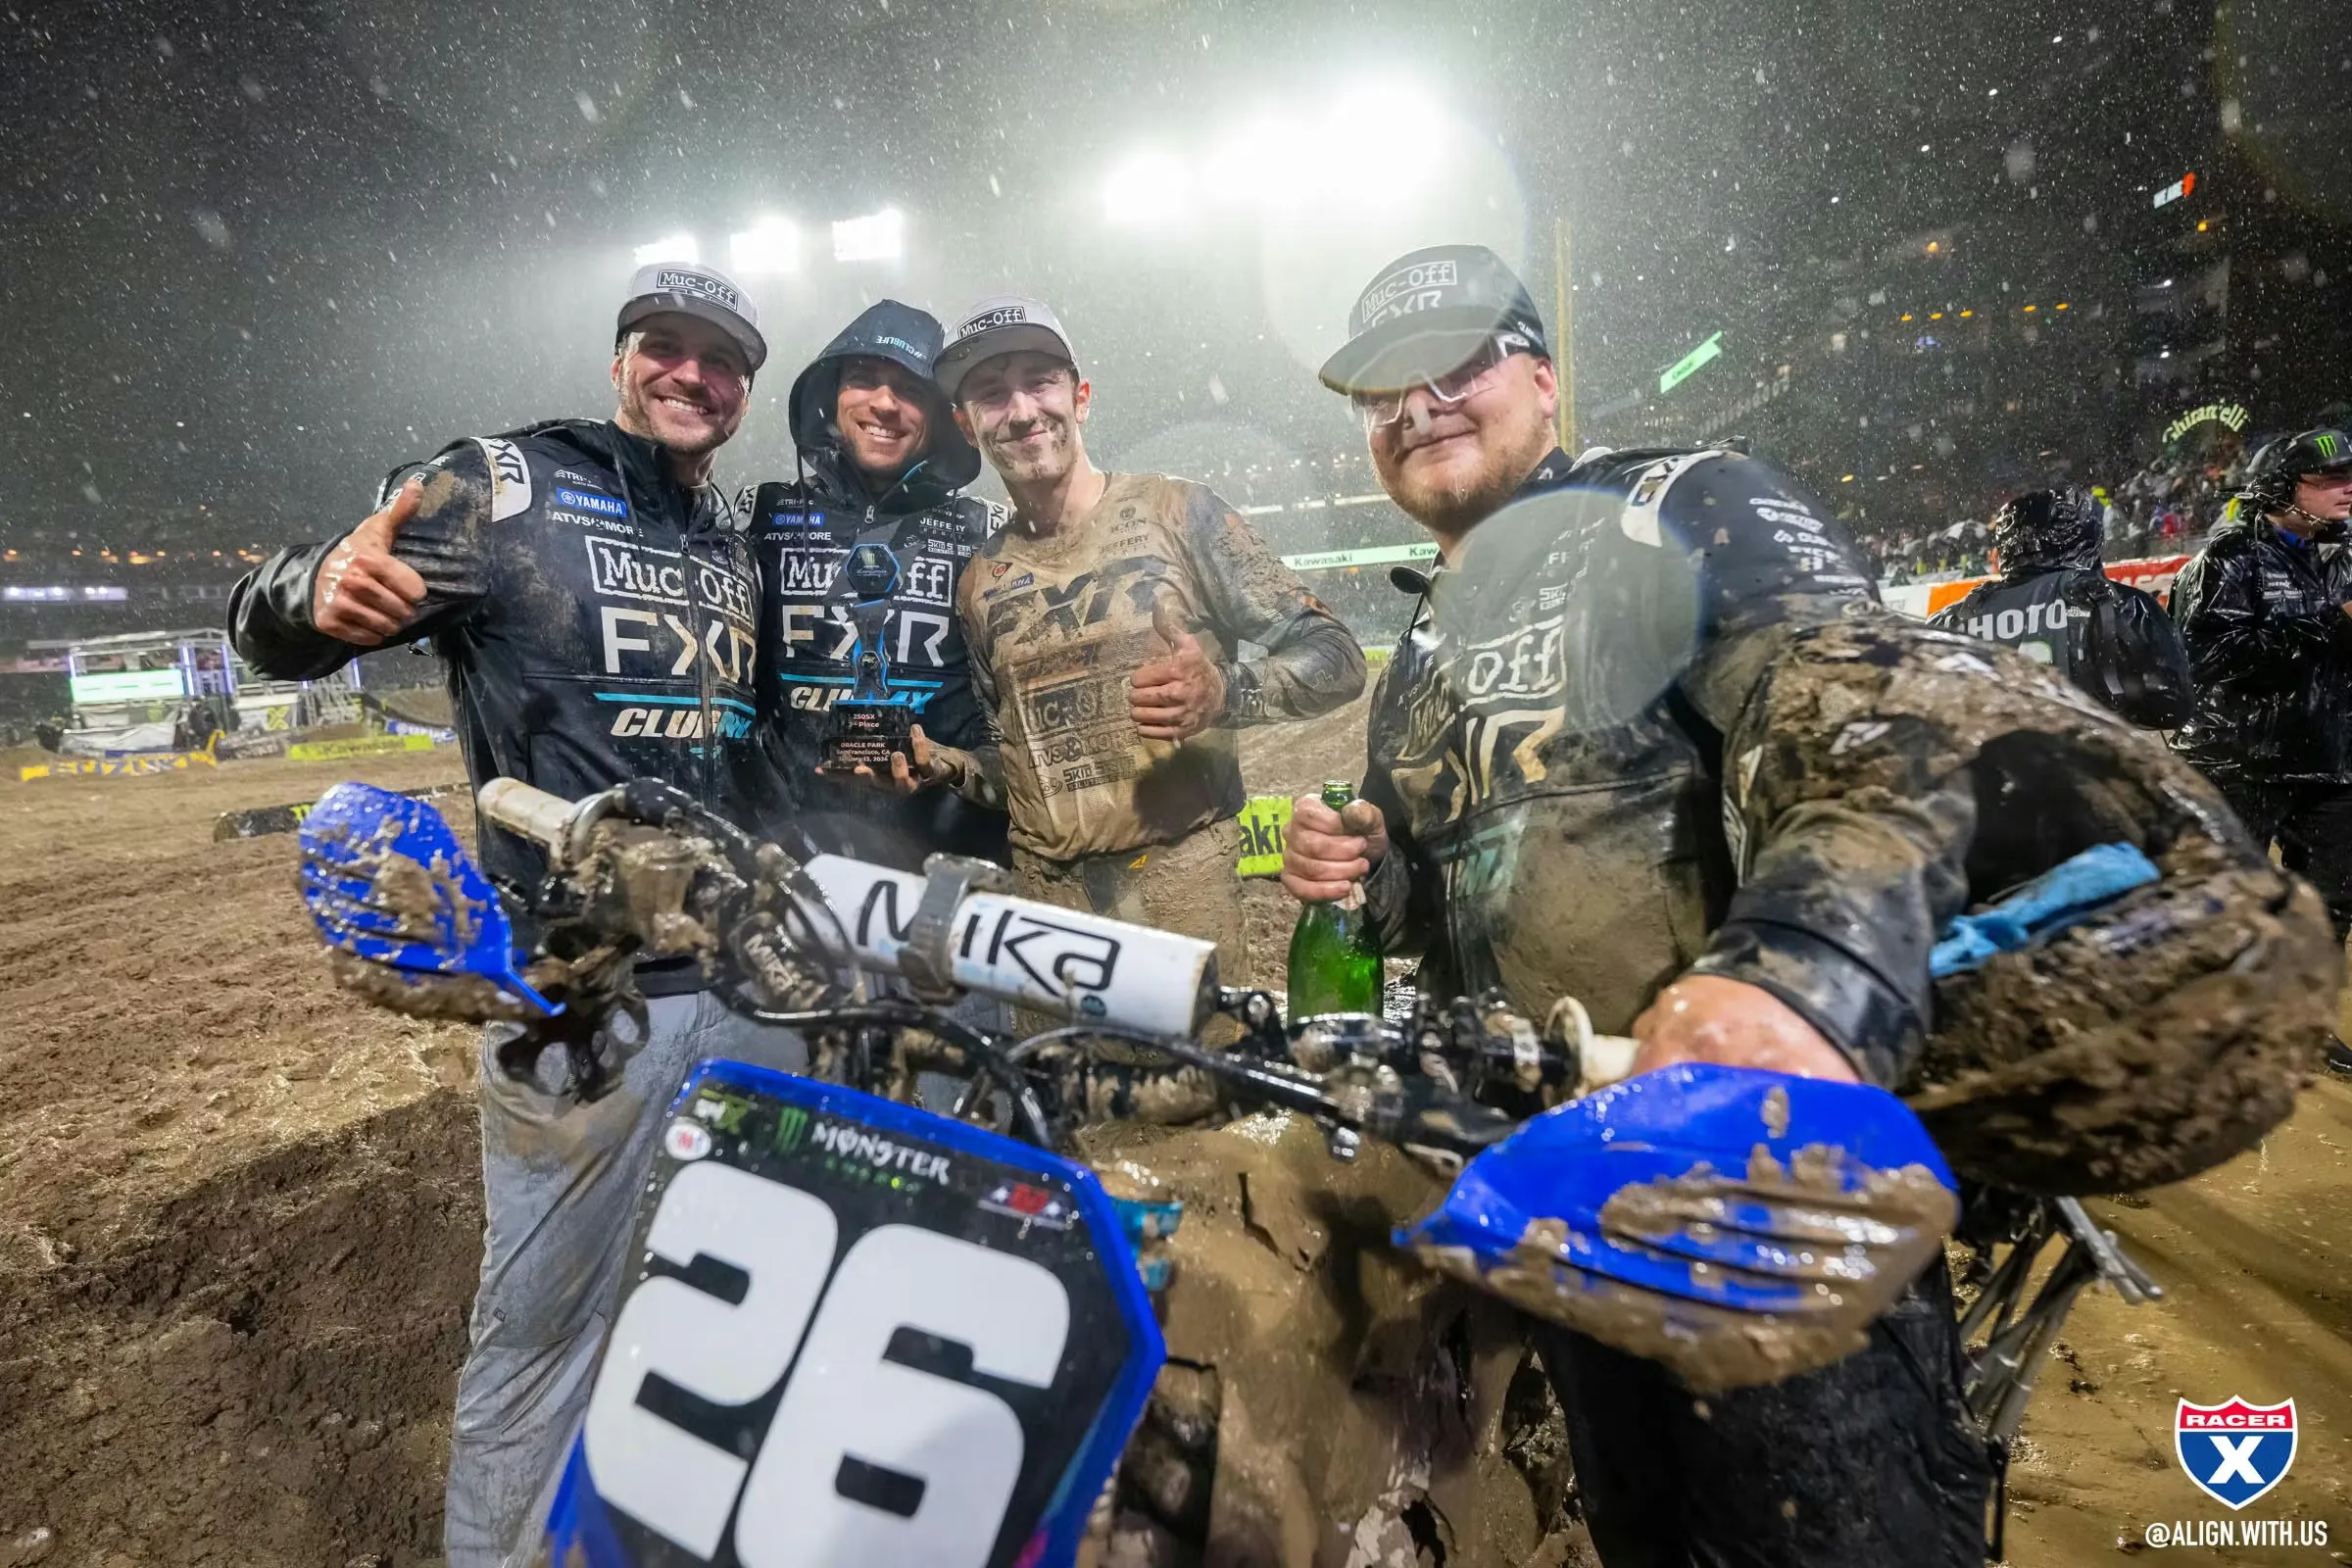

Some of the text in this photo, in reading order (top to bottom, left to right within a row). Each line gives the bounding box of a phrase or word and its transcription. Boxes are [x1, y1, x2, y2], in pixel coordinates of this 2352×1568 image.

[662, 272, 735, 303] Muc-Off
[1364, 264, 1451, 317] Muc-Off
[960, 309, 1023, 337] Muc-Off
[490, 438, 525, 484] XR
[575, 494, 623, 514] YAMAHA
[786, 515, 820, 524] YAMHA
[1294, 554, 1352, 567] Kawasaki
[599, 547, 751, 620] MucOff
[1959, 599, 2068, 641] HOTO
[601, 607, 758, 686] FXR
[1239, 814, 1283, 858] aki
[811, 1121, 951, 1186] MONSTER
[583, 1159, 1070, 1568] 26
